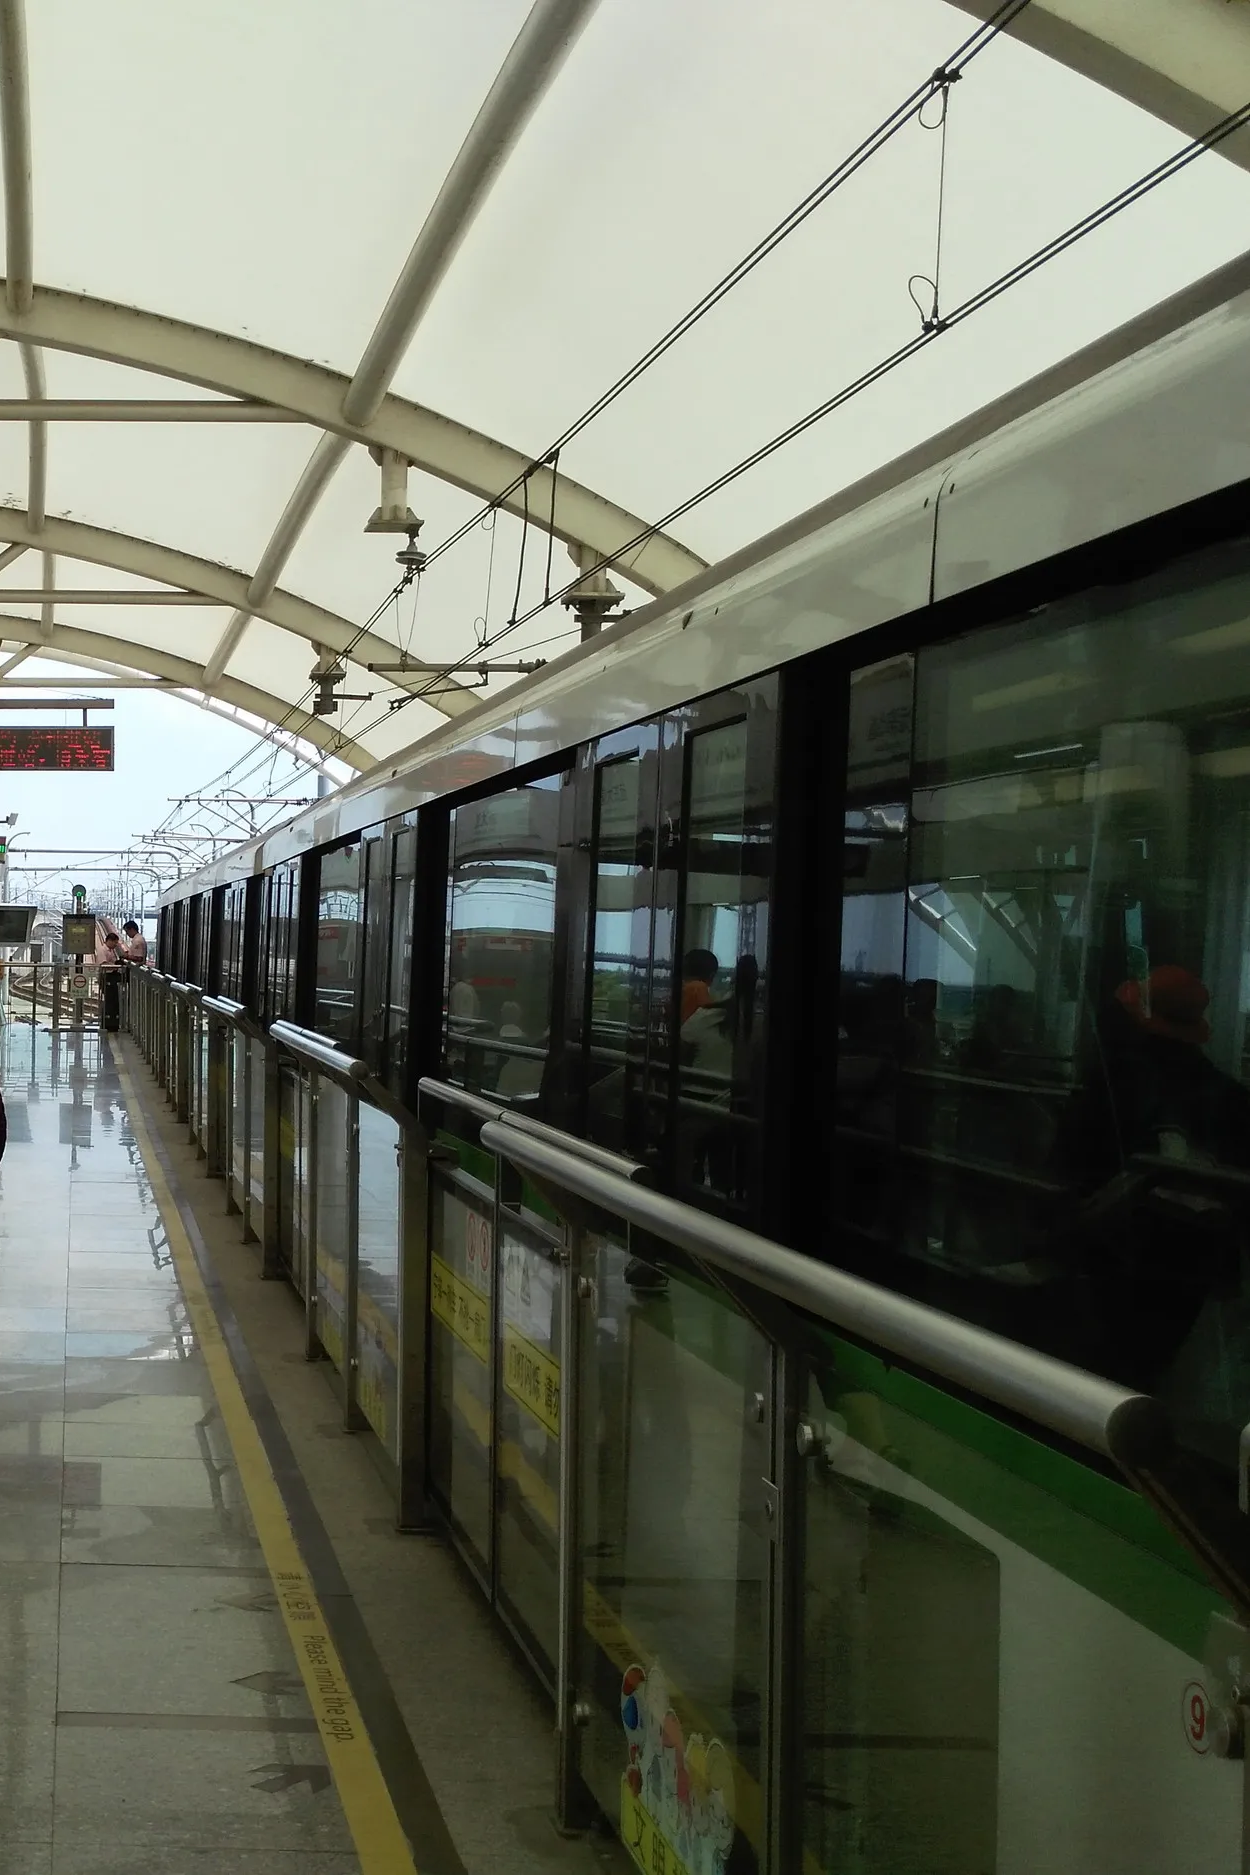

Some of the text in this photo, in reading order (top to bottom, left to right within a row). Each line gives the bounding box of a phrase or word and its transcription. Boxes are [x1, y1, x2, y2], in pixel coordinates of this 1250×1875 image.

[302, 1635, 329, 1666] Please
[313, 1667, 342, 1694] mind
[323, 1694, 350, 1715] the
